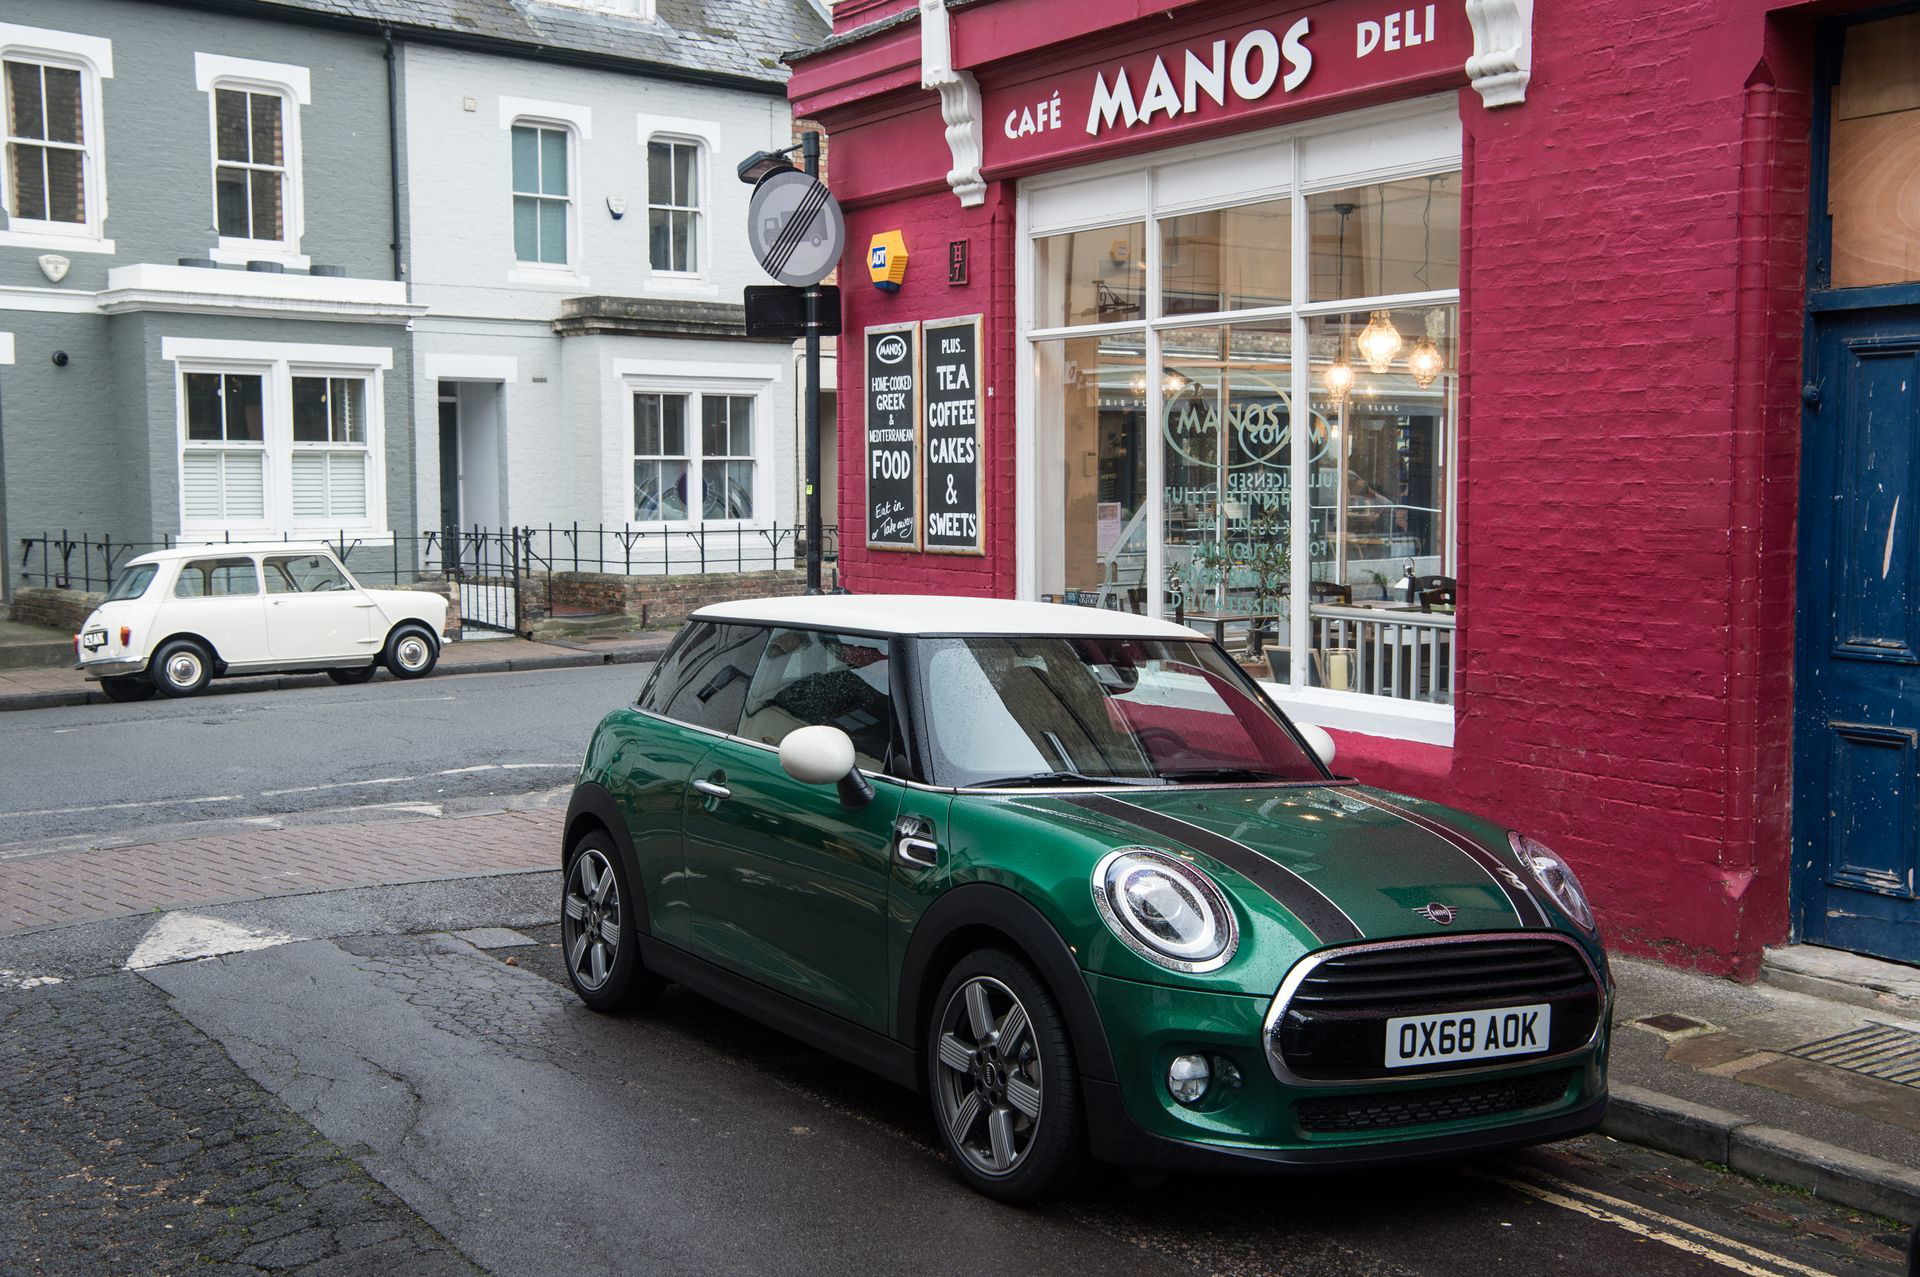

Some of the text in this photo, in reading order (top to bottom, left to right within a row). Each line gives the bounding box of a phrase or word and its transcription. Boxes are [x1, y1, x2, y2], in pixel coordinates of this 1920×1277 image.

[1004, 4, 1436, 139] CAFÉ MANOS DELI
[872, 250, 887, 266] ADT
[879, 343, 902, 356] MANOS
[871, 375, 912, 392] HOME-COOKED
[936, 364, 970, 391] TEA
[876, 393, 906, 411] GREEK
[929, 400, 976, 428] COFFEE
[889, 413, 895, 426] &
[1176, 403, 1279, 434] MANOS
[869, 429, 914, 443] MEDITERRANEAN
[930, 437, 975, 464] CAKES
[872, 449, 911, 480] FOOD
[945, 473, 958, 505] &
[875, 500, 905, 519] Eat in
[929, 512, 977, 537] SWEETS
[901, 820, 919, 836] 60
[1399, 1011, 1539, 1059] OX68 AOK
